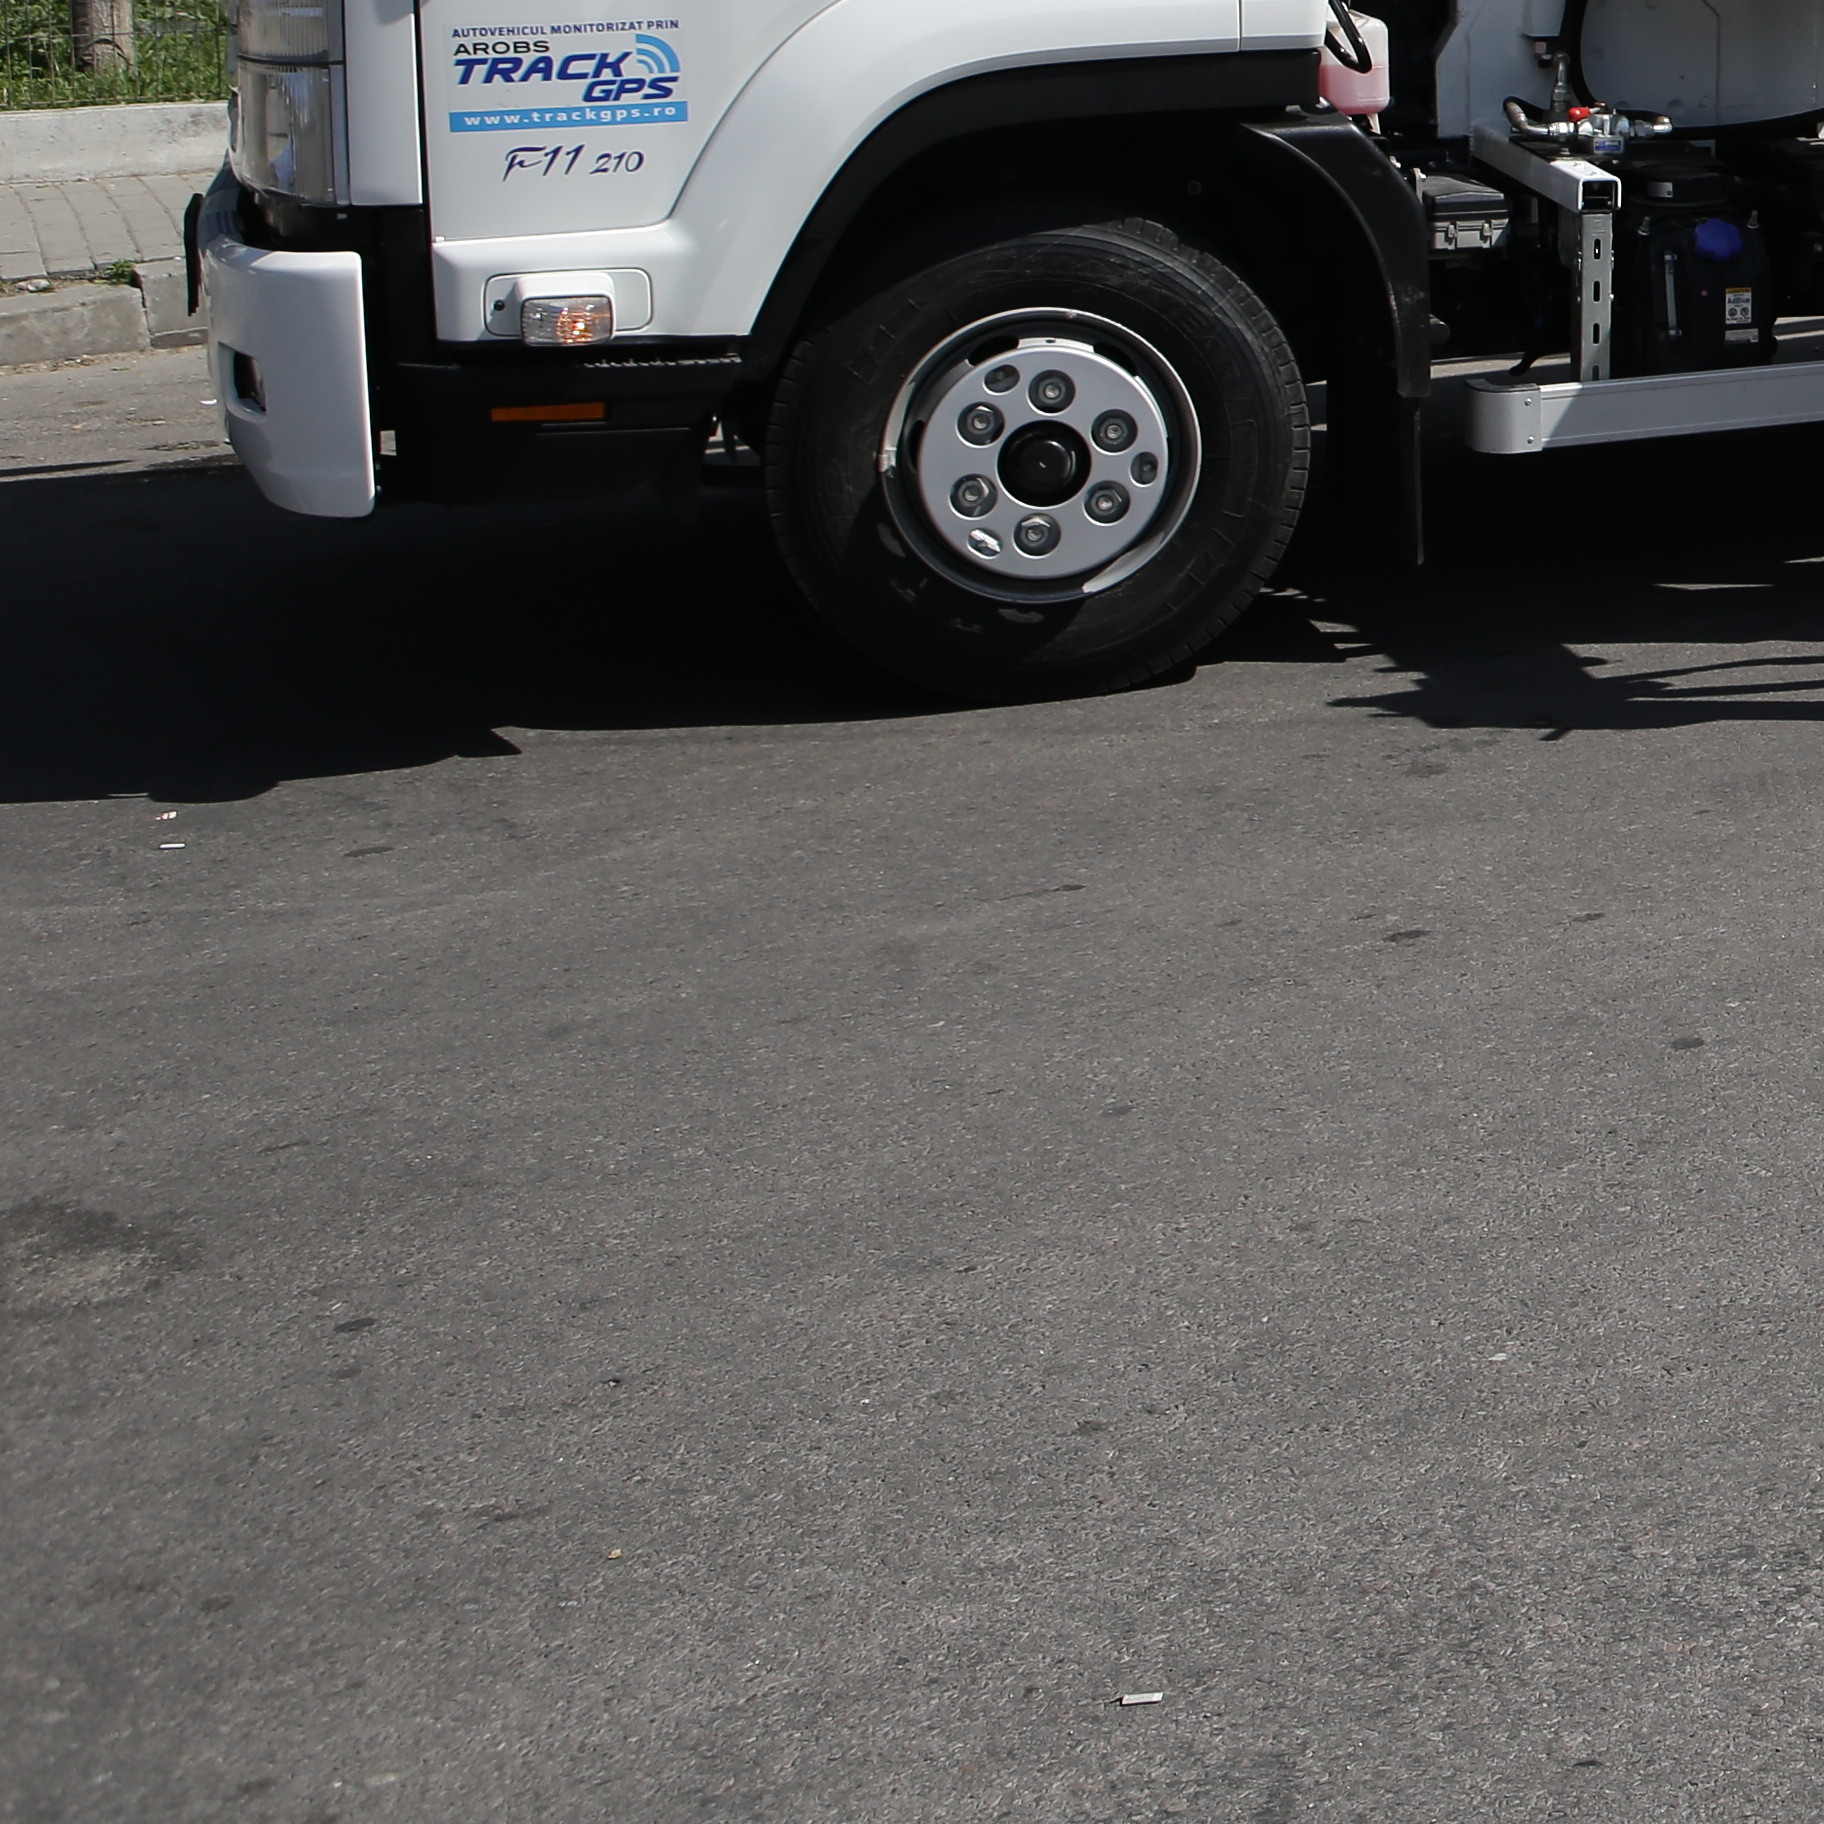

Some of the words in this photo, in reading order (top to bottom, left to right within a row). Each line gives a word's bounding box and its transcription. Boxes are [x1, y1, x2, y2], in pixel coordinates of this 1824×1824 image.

[452, 26, 548, 38] AUTOVEHICUL
[550, 21, 644, 35] MONITORIZAT
[647, 19, 679, 30] PRIN
[453, 40, 550, 56] AROBS
[454, 52, 633, 85] TRACK
[582, 76, 680, 102] GPS
[463, 106, 677, 126] www.trackgps.ro
[503, 144, 586, 182] F11
[590, 151, 644, 175] 210
